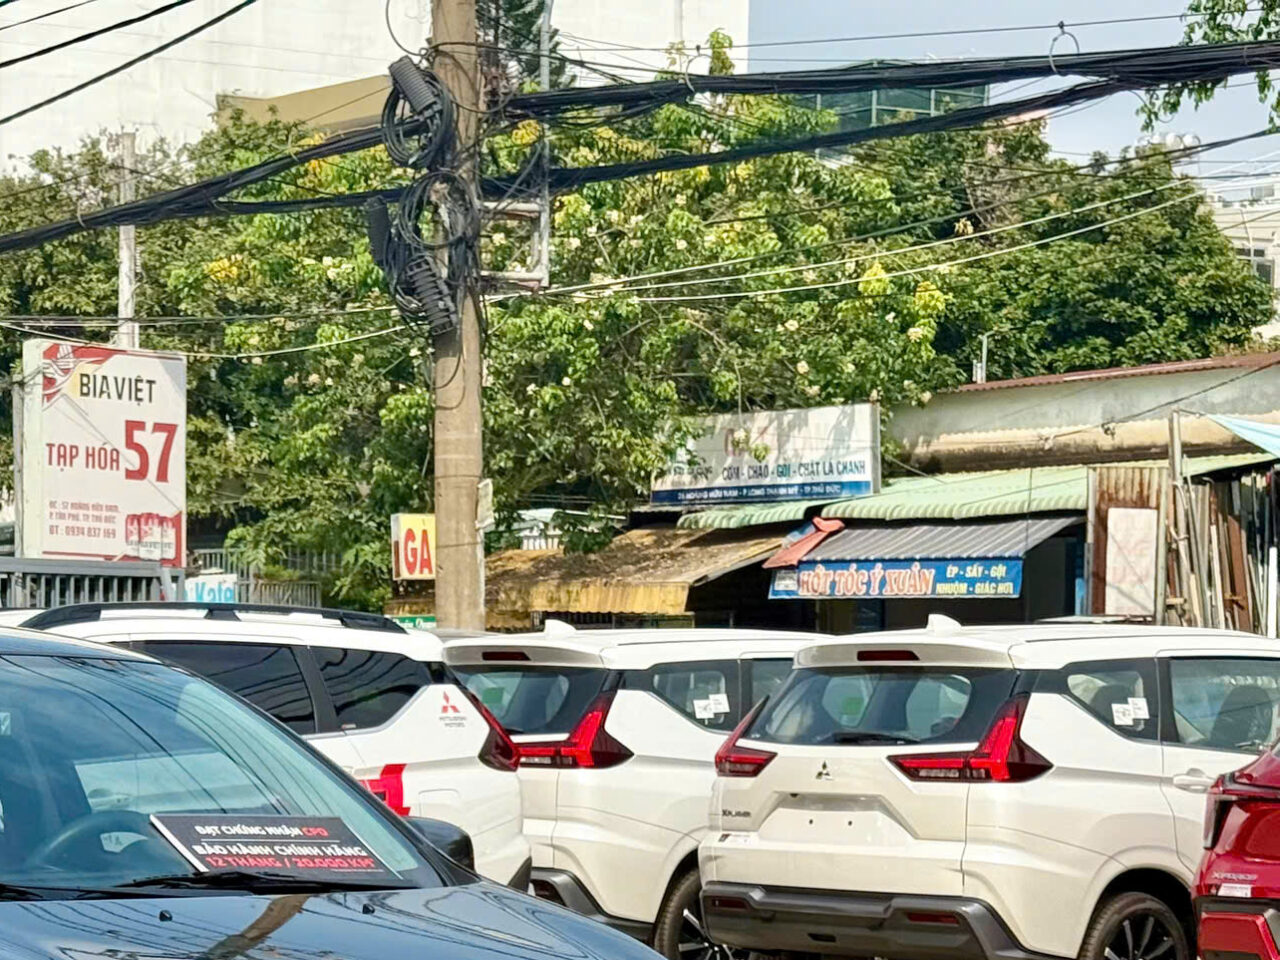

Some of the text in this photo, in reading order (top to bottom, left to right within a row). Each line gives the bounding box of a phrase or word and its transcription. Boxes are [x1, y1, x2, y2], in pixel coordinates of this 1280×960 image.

[79, 373, 157, 406] BIA VIỆT
[46, 441, 121, 472] TẠP HÓA
[124, 419, 179, 484] 57
[834, 563, 868, 595] TÓC
[883, 561, 936, 595] XUÂN
[194, 824, 329, 837] ĐẠT CHỨNG NHẬN CPO
[192, 841, 369, 857] BẢO HÀNH CHÍNH HÃNG
[205, 855, 375, 869] 12 THÁNG / 20.000 KM
